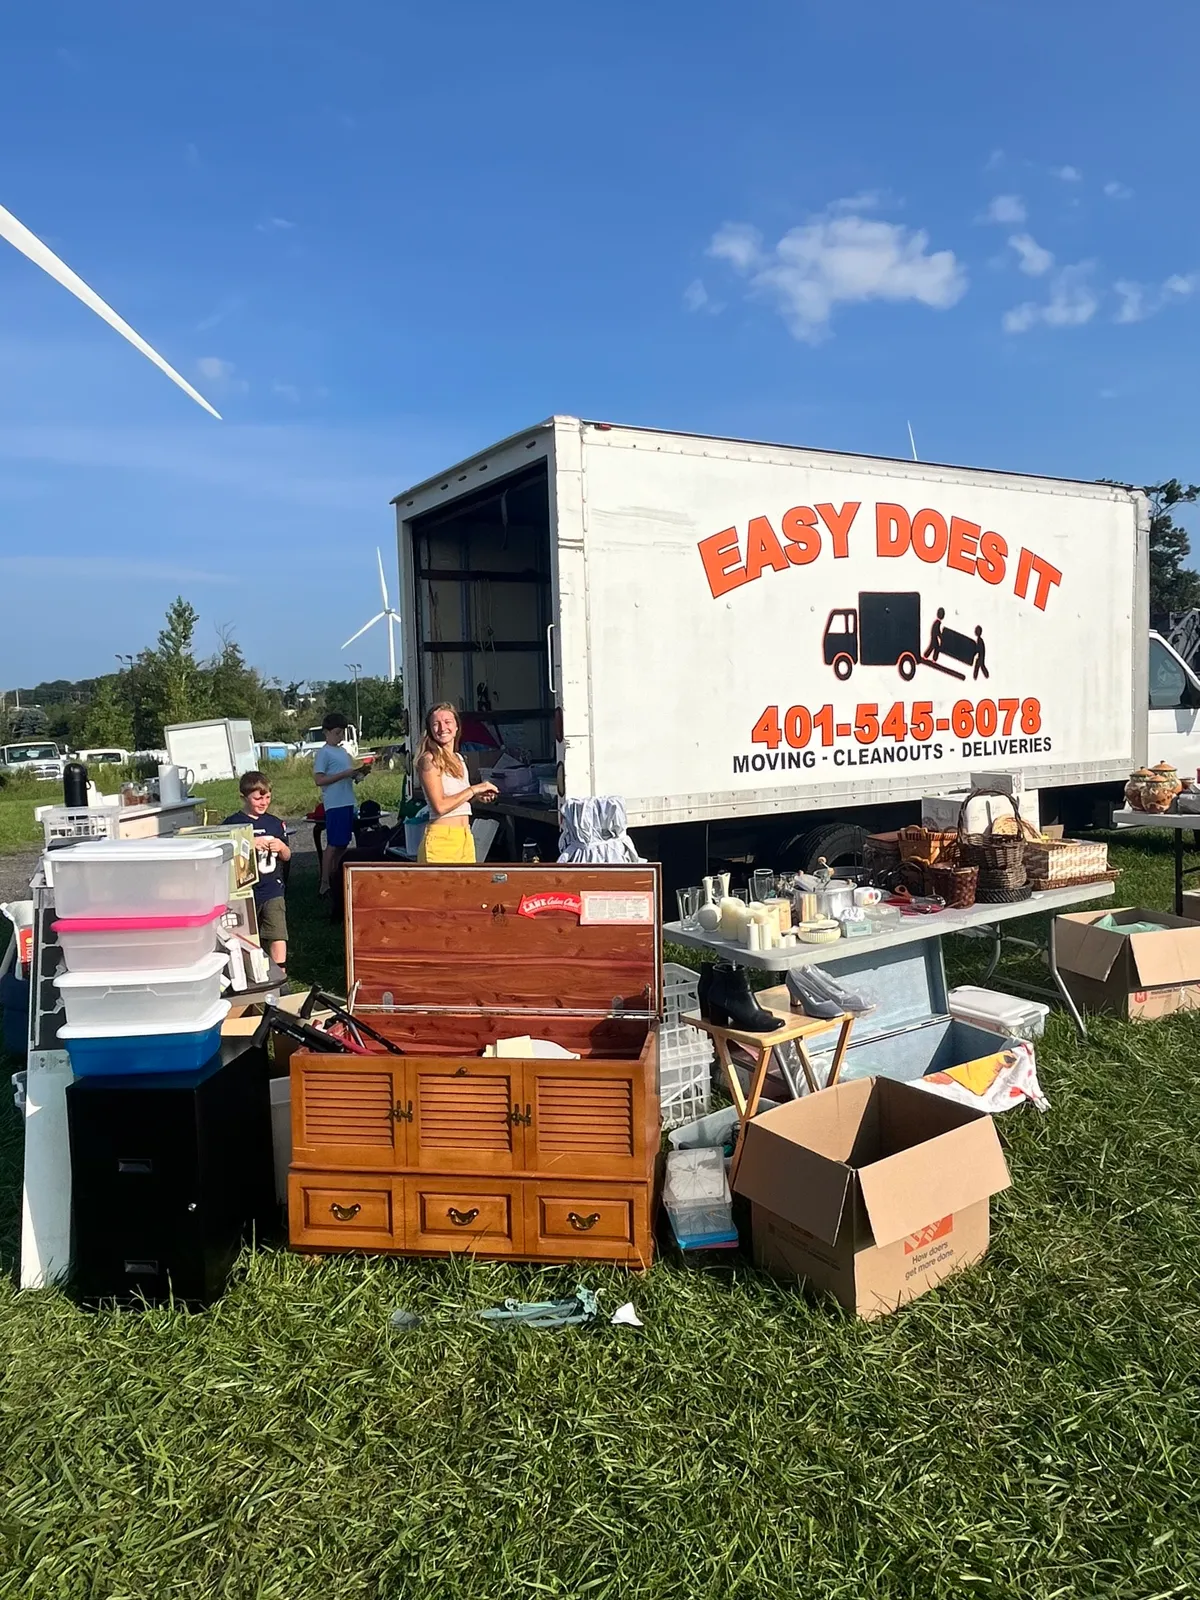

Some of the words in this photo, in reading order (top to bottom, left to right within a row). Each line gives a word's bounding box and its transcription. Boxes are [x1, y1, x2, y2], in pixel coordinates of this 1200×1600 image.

[697, 501, 861, 599] EASY
[875, 502, 1008, 585] DOES
[1013, 546, 1063, 612] IT
[751, 697, 1042, 750] 401-545-6078
[732, 750, 816, 773] MOVING
[833, 744, 944, 767] CLEANOUTS
[961, 736, 1053, 759] DELIVERIES
[522, 898, 547, 912] LANE
[912, 1252, 928, 1265] How
[929, 1241, 949, 1256] doers
[905, 1267, 917, 1281] get
[918, 1258, 936, 1273] more
